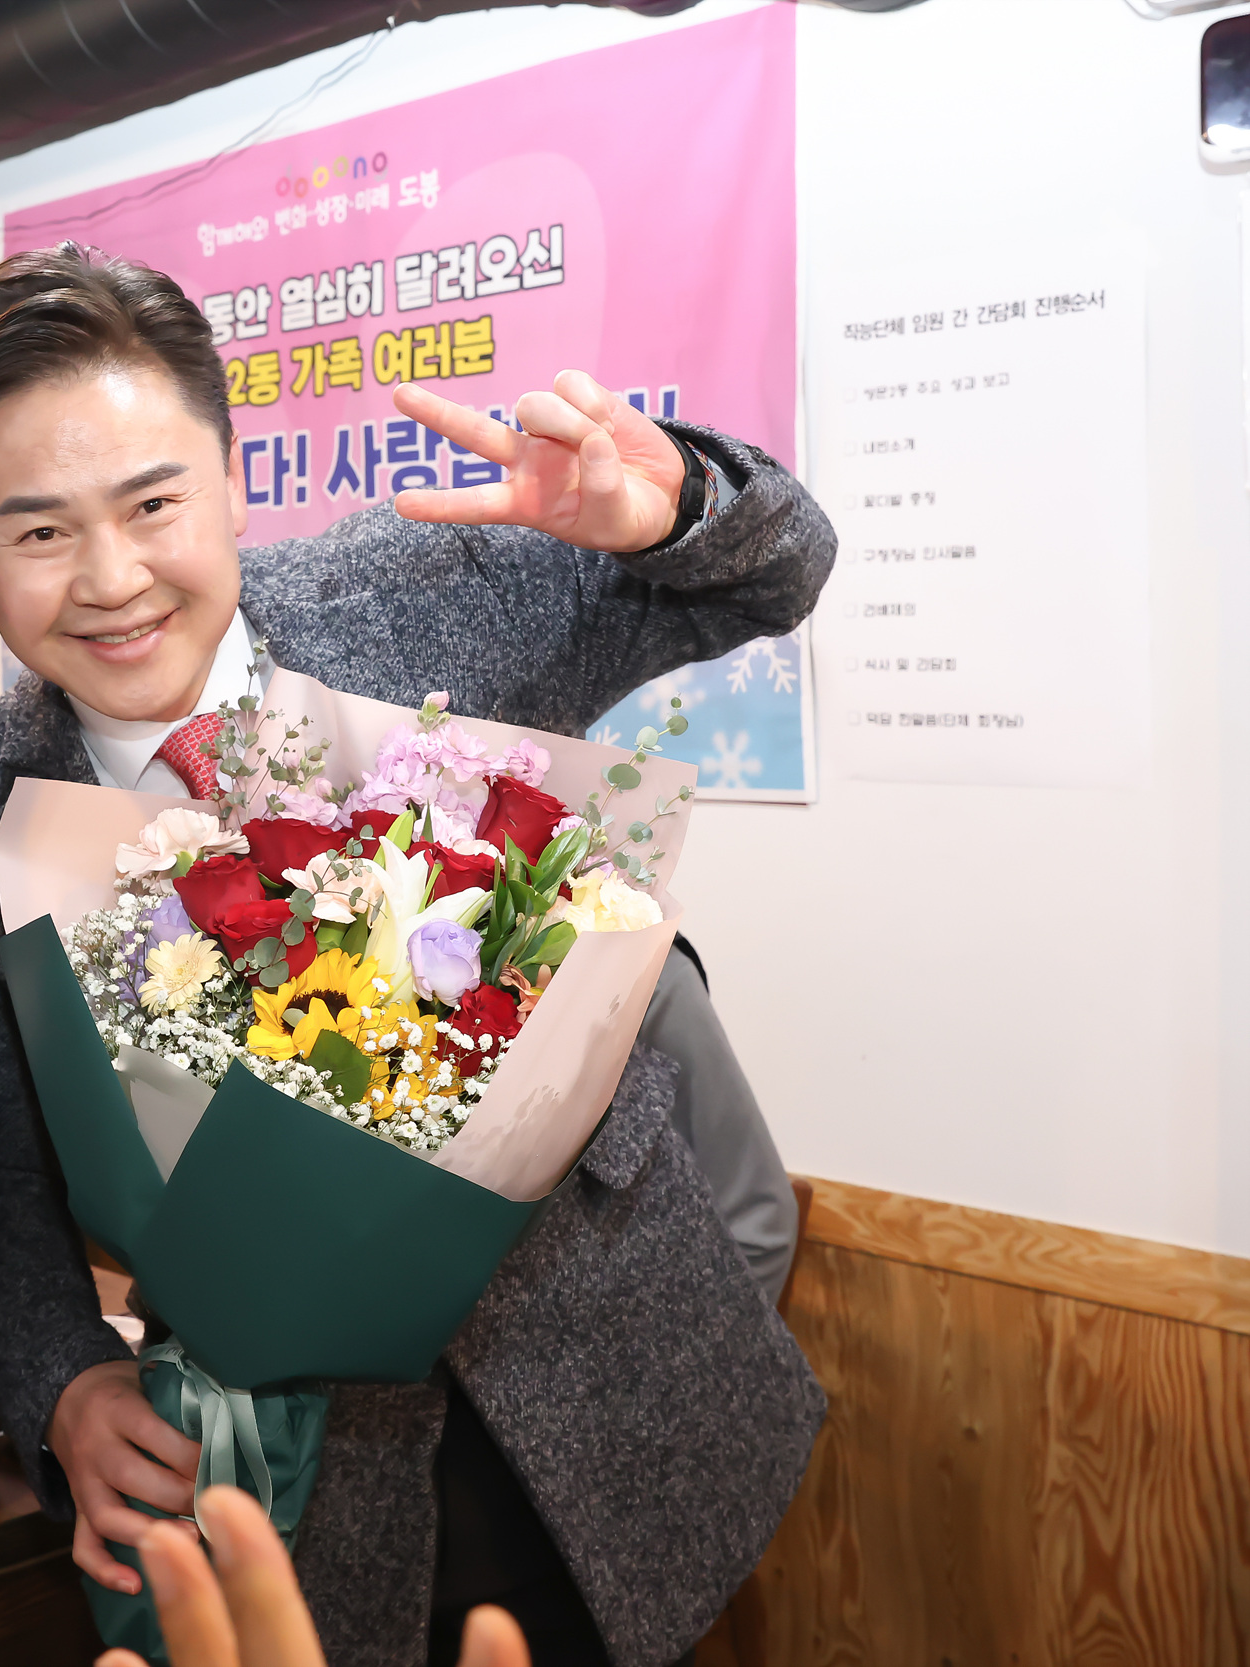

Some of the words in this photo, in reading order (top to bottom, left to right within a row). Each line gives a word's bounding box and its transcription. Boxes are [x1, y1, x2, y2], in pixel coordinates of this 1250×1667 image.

[397, 167, 441, 209] 도봉
[202, 284, 272, 347] 동안
[279, 259, 385, 333] 열심히
[395, 223, 565, 312] 달려오신
[913, 311, 944, 334] 임원
[953, 308, 968, 328] 간
[977, 301, 1026, 326] 간담회
[1035, 289, 1105, 317] 진행순서
[225, 350, 282, 407] 2동
[290, 335, 363, 397] 가족
[372, 314, 495, 386] 여러분
